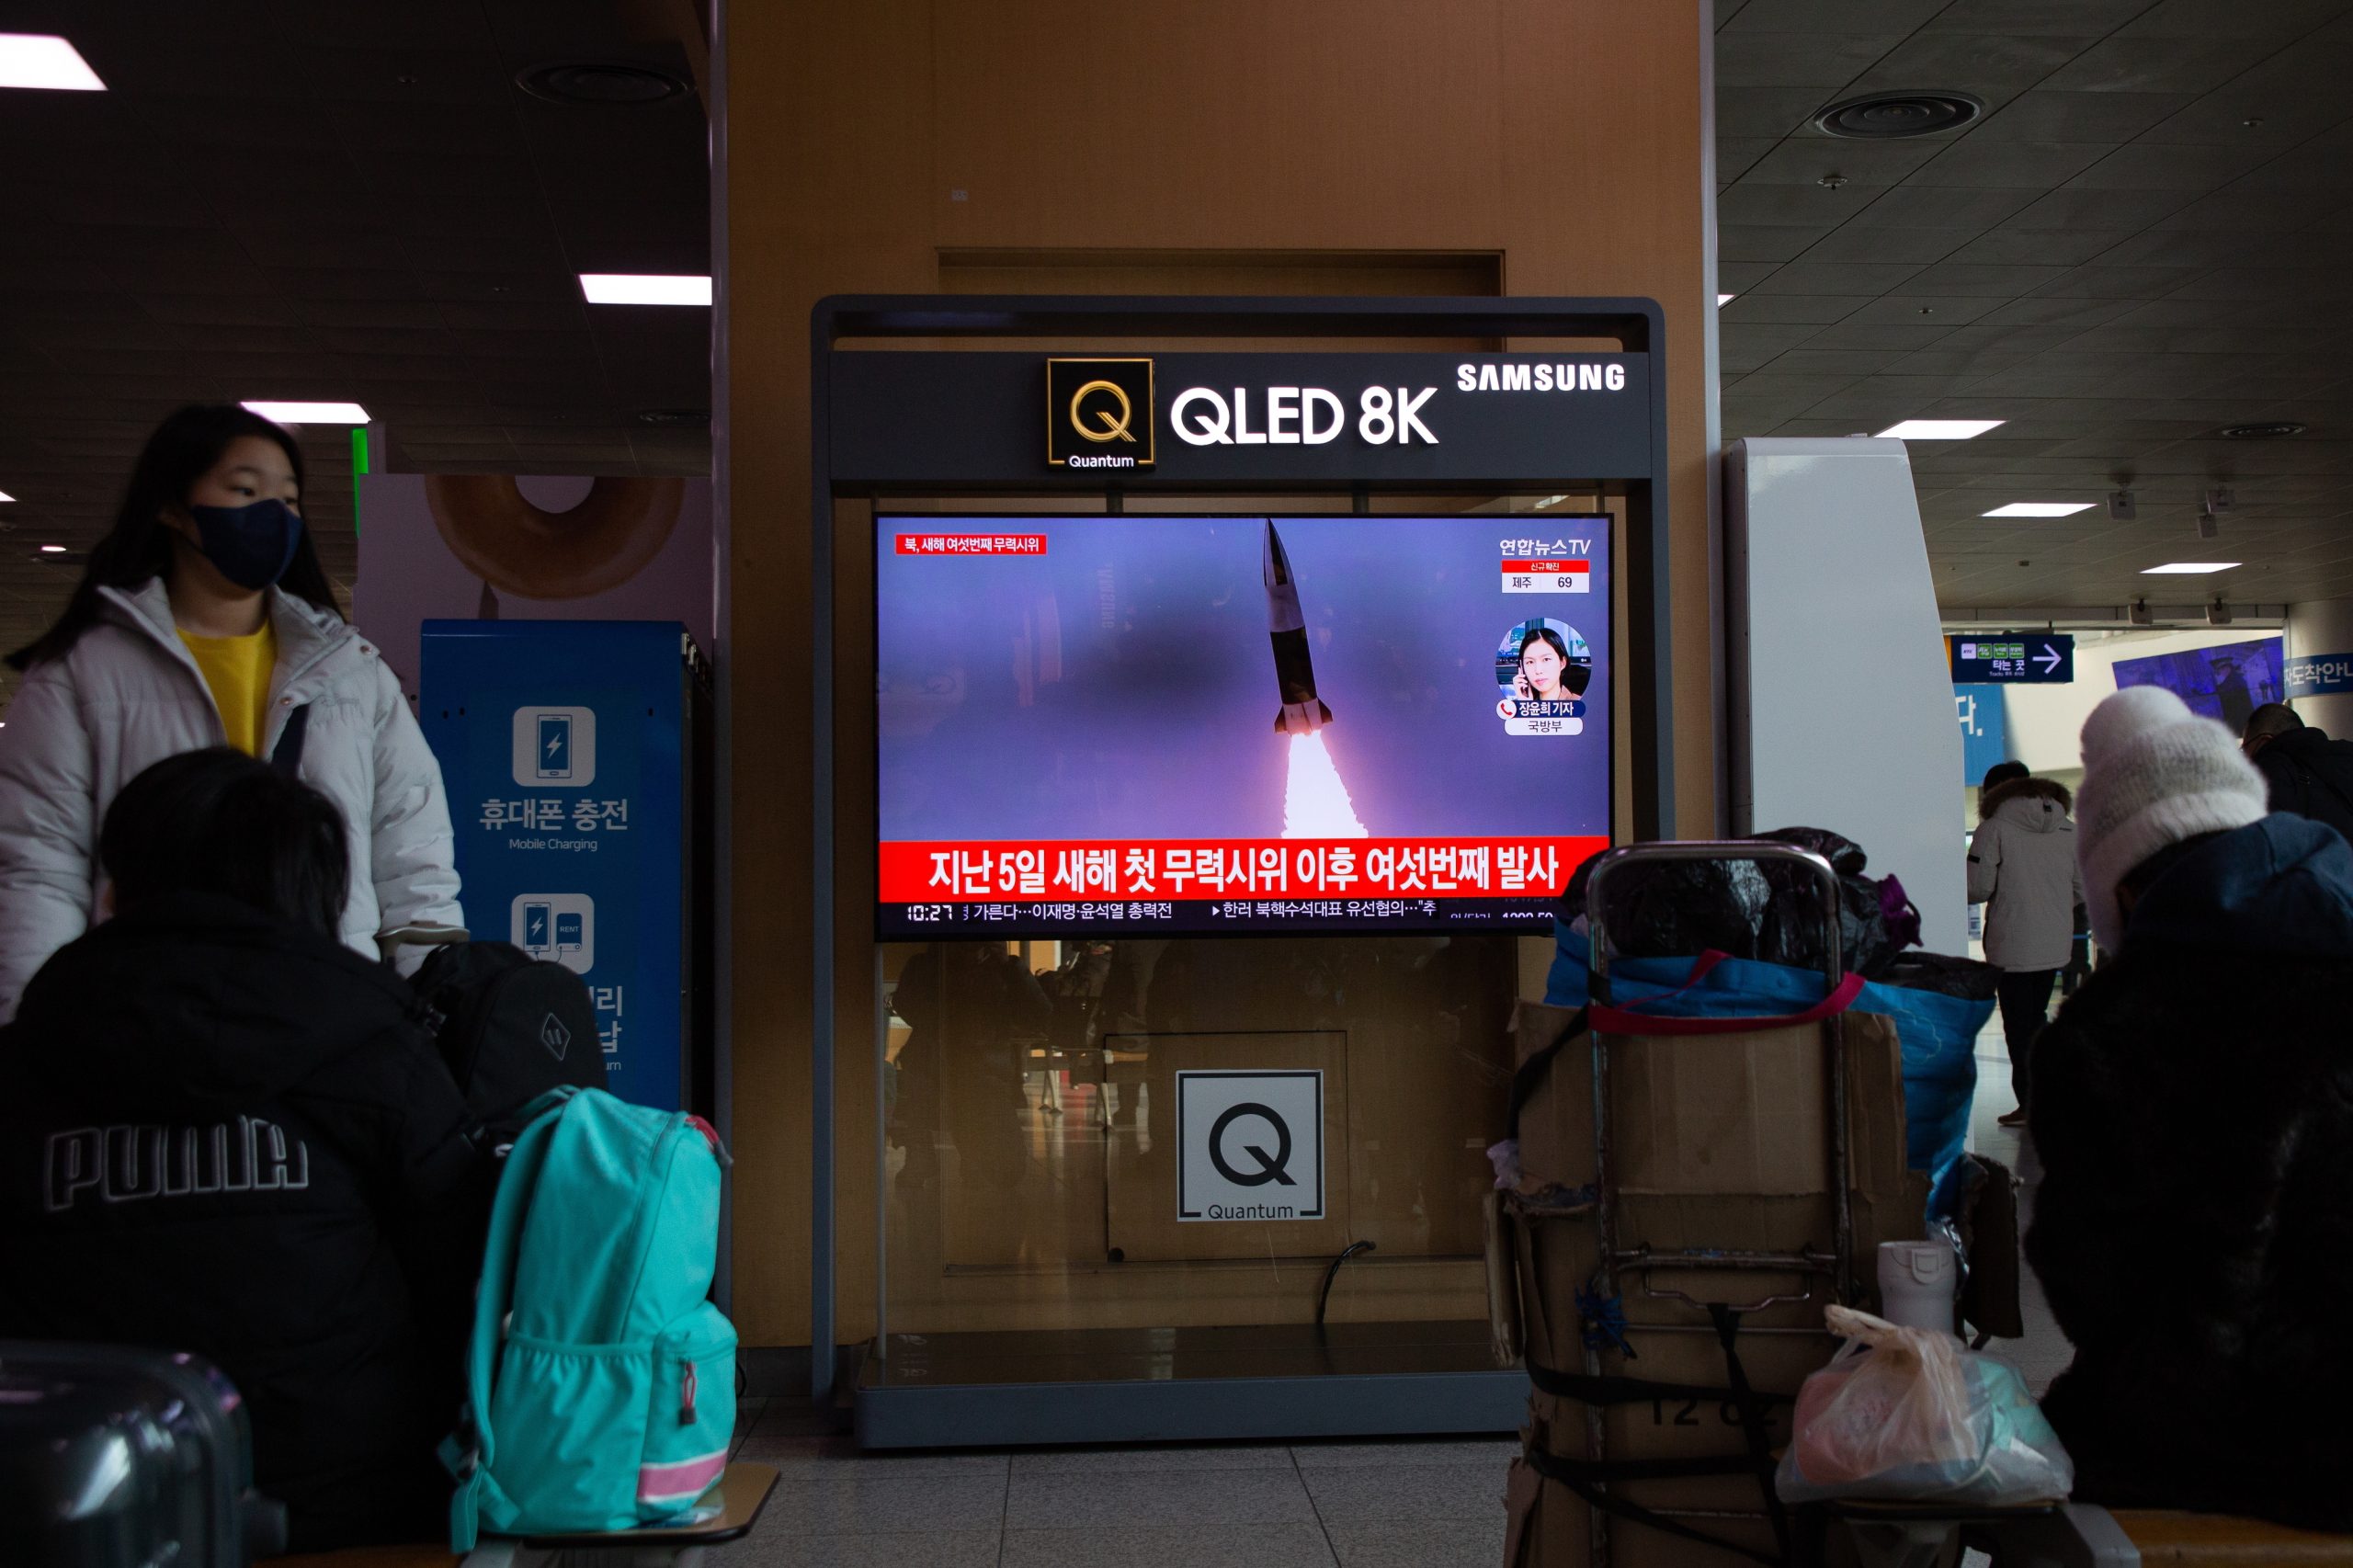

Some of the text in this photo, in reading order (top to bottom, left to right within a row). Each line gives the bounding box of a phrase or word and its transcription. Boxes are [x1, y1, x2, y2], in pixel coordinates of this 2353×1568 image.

[1458, 364, 1624, 391] SAMSUNG
[1070, 380, 1136, 442] Q
[1171, 386, 1438, 446] QLED 8K
[1069, 455, 1133, 467] Quantum
[904, 537, 1039, 553] 북, 새해 여섯번째 무력시위
[1500, 540, 1591, 555] 연합뉴스TV
[1513, 577, 1572, 588] 제주 69
[1519, 702, 1574, 716] 장윤희 기자
[1529, 721, 1562, 733] 국방부
[480, 799, 627, 831] 휴대폰 충전
[509, 839, 597, 851] Mobile Charging
[929, 846, 1559, 894] 지난 5일 새해 첫 무력시위 이후 여섯번째 발사
[908, 905, 952, 921] 10:27
[1129, 903, 1171, 919] 총력전
[1223, 902, 1251, 917] 한러
[1256, 902, 1343, 917] 북핵수석대표
[589, 985, 622, 1017] 리
[1209, 1103, 1297, 1187] Q
[44, 1114, 309, 1212] PUMA
[1208, 1203, 1293, 1220] Quantum
